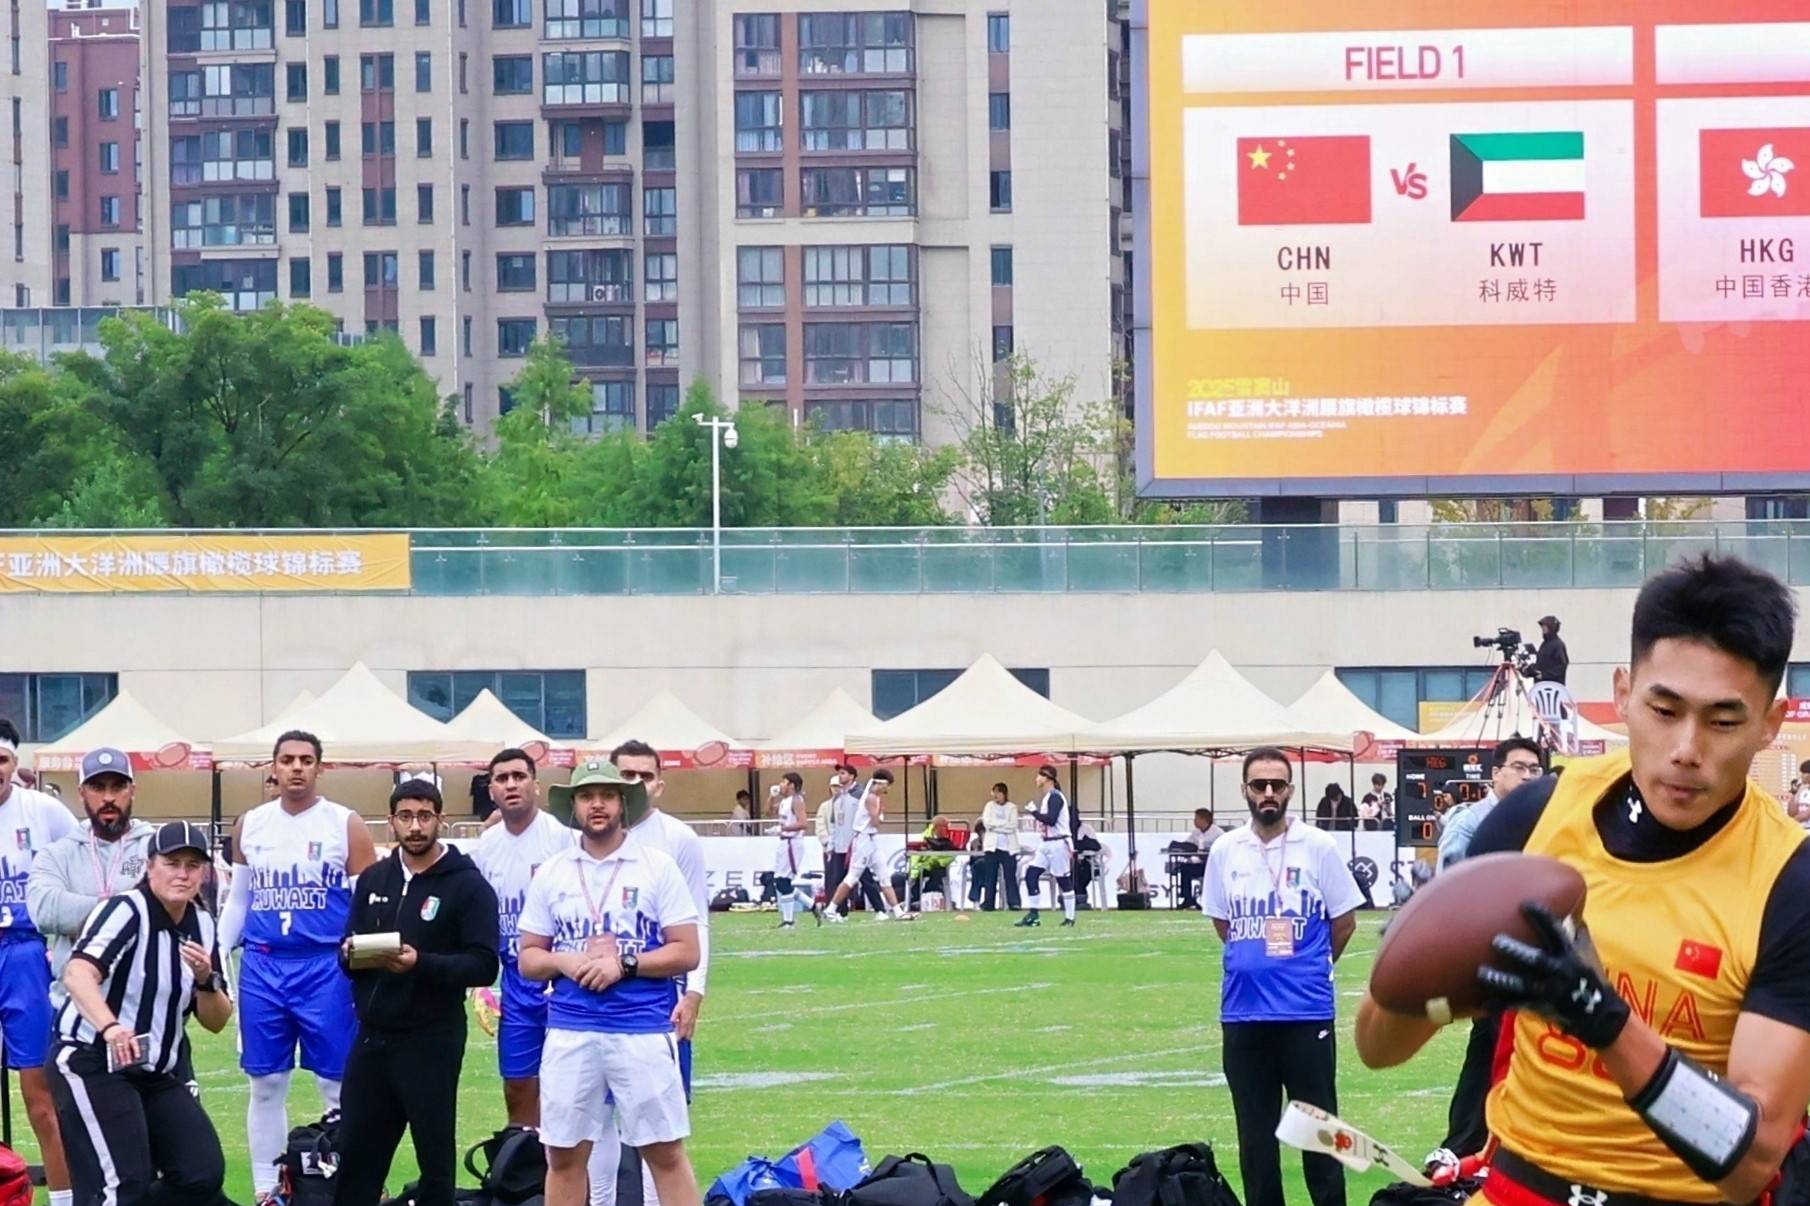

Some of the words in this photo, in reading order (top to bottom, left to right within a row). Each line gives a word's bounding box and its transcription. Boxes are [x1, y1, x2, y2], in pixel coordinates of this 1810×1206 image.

[1345, 45, 1442, 80] FIELD
[1452, 45, 1464, 79] 1
[1277, 246, 1331, 271] CHN
[1489, 242, 1543, 267] KWT
[1739, 238, 1794, 263] HKG
[1279, 281, 1329, 306] 中国
[1478, 277, 1558, 303] 科威特
[279, 911, 292, 936] 7
